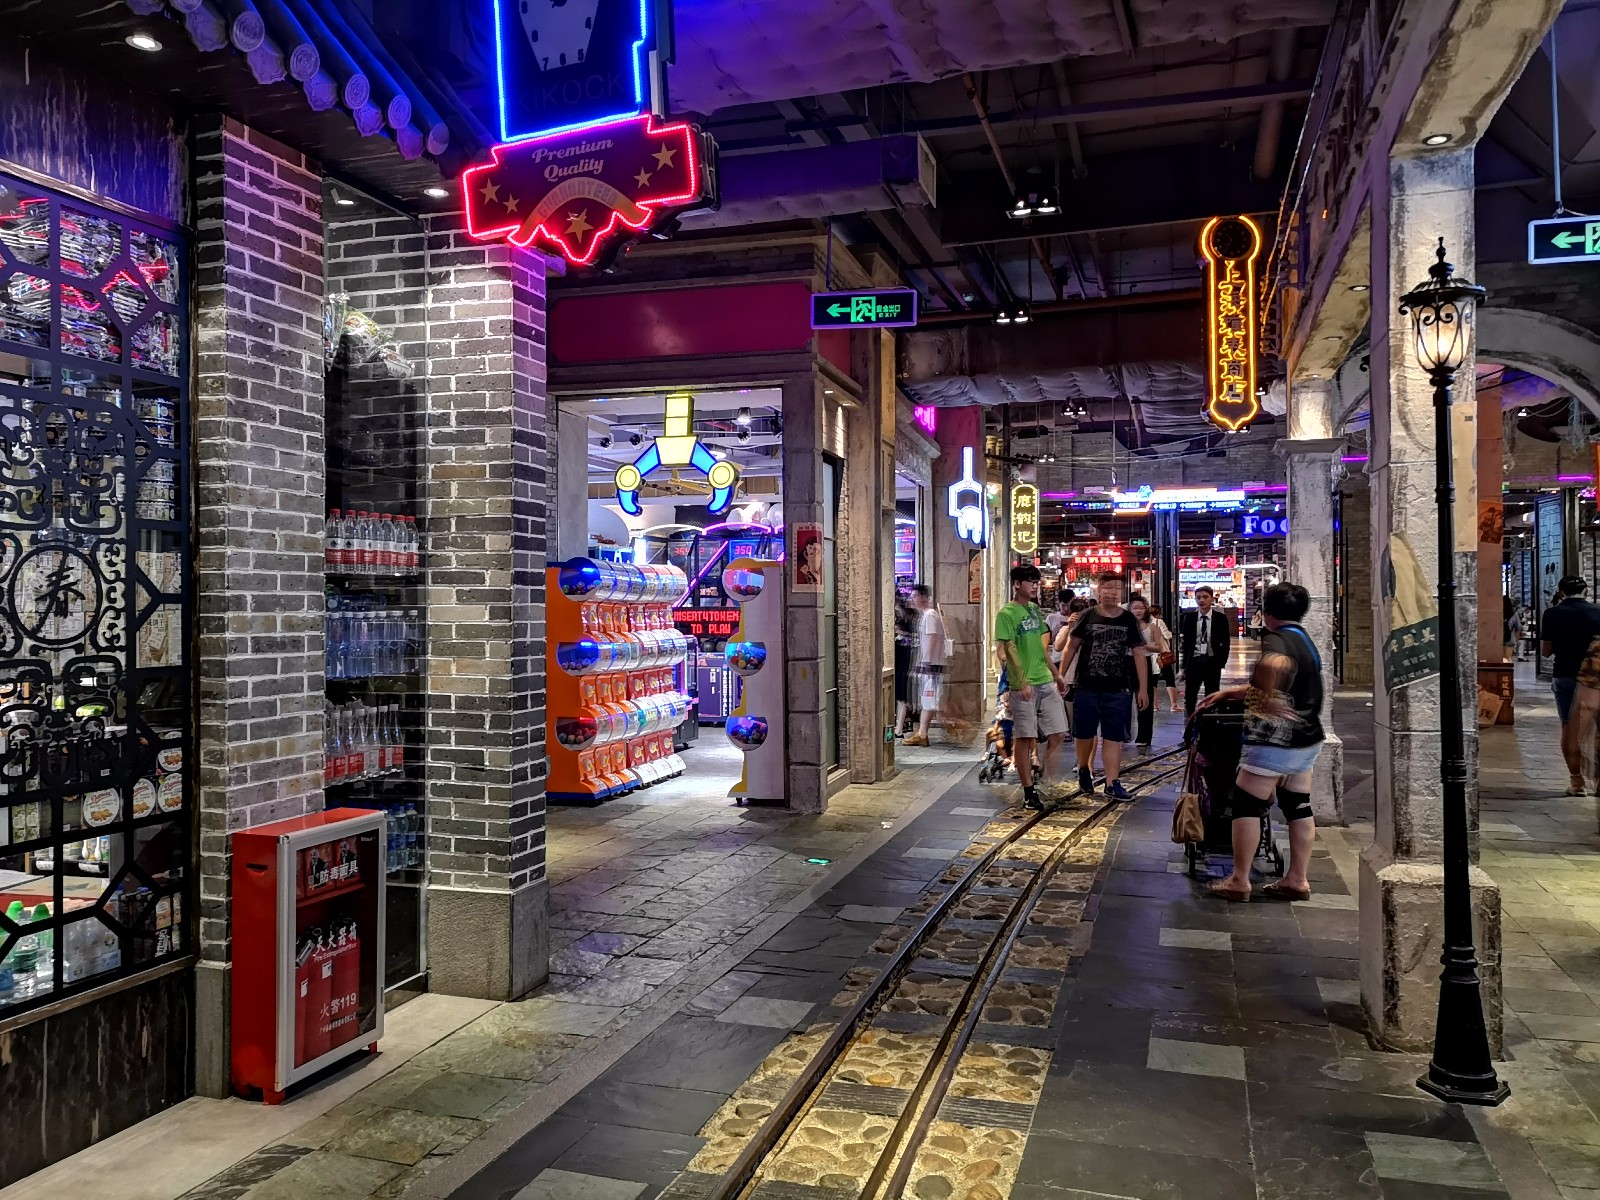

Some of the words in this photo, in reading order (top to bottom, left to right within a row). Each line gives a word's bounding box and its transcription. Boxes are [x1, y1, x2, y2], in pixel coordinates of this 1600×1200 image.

[532, 139, 613, 163] Premium
[544, 158, 604, 182] Quality
[1016, 494, 1034, 543] 鹿韵记
[691, 623, 702, 634] TO
[708, 623, 731, 634] PLAY
[319, 860, 359, 884] 防毒面具
